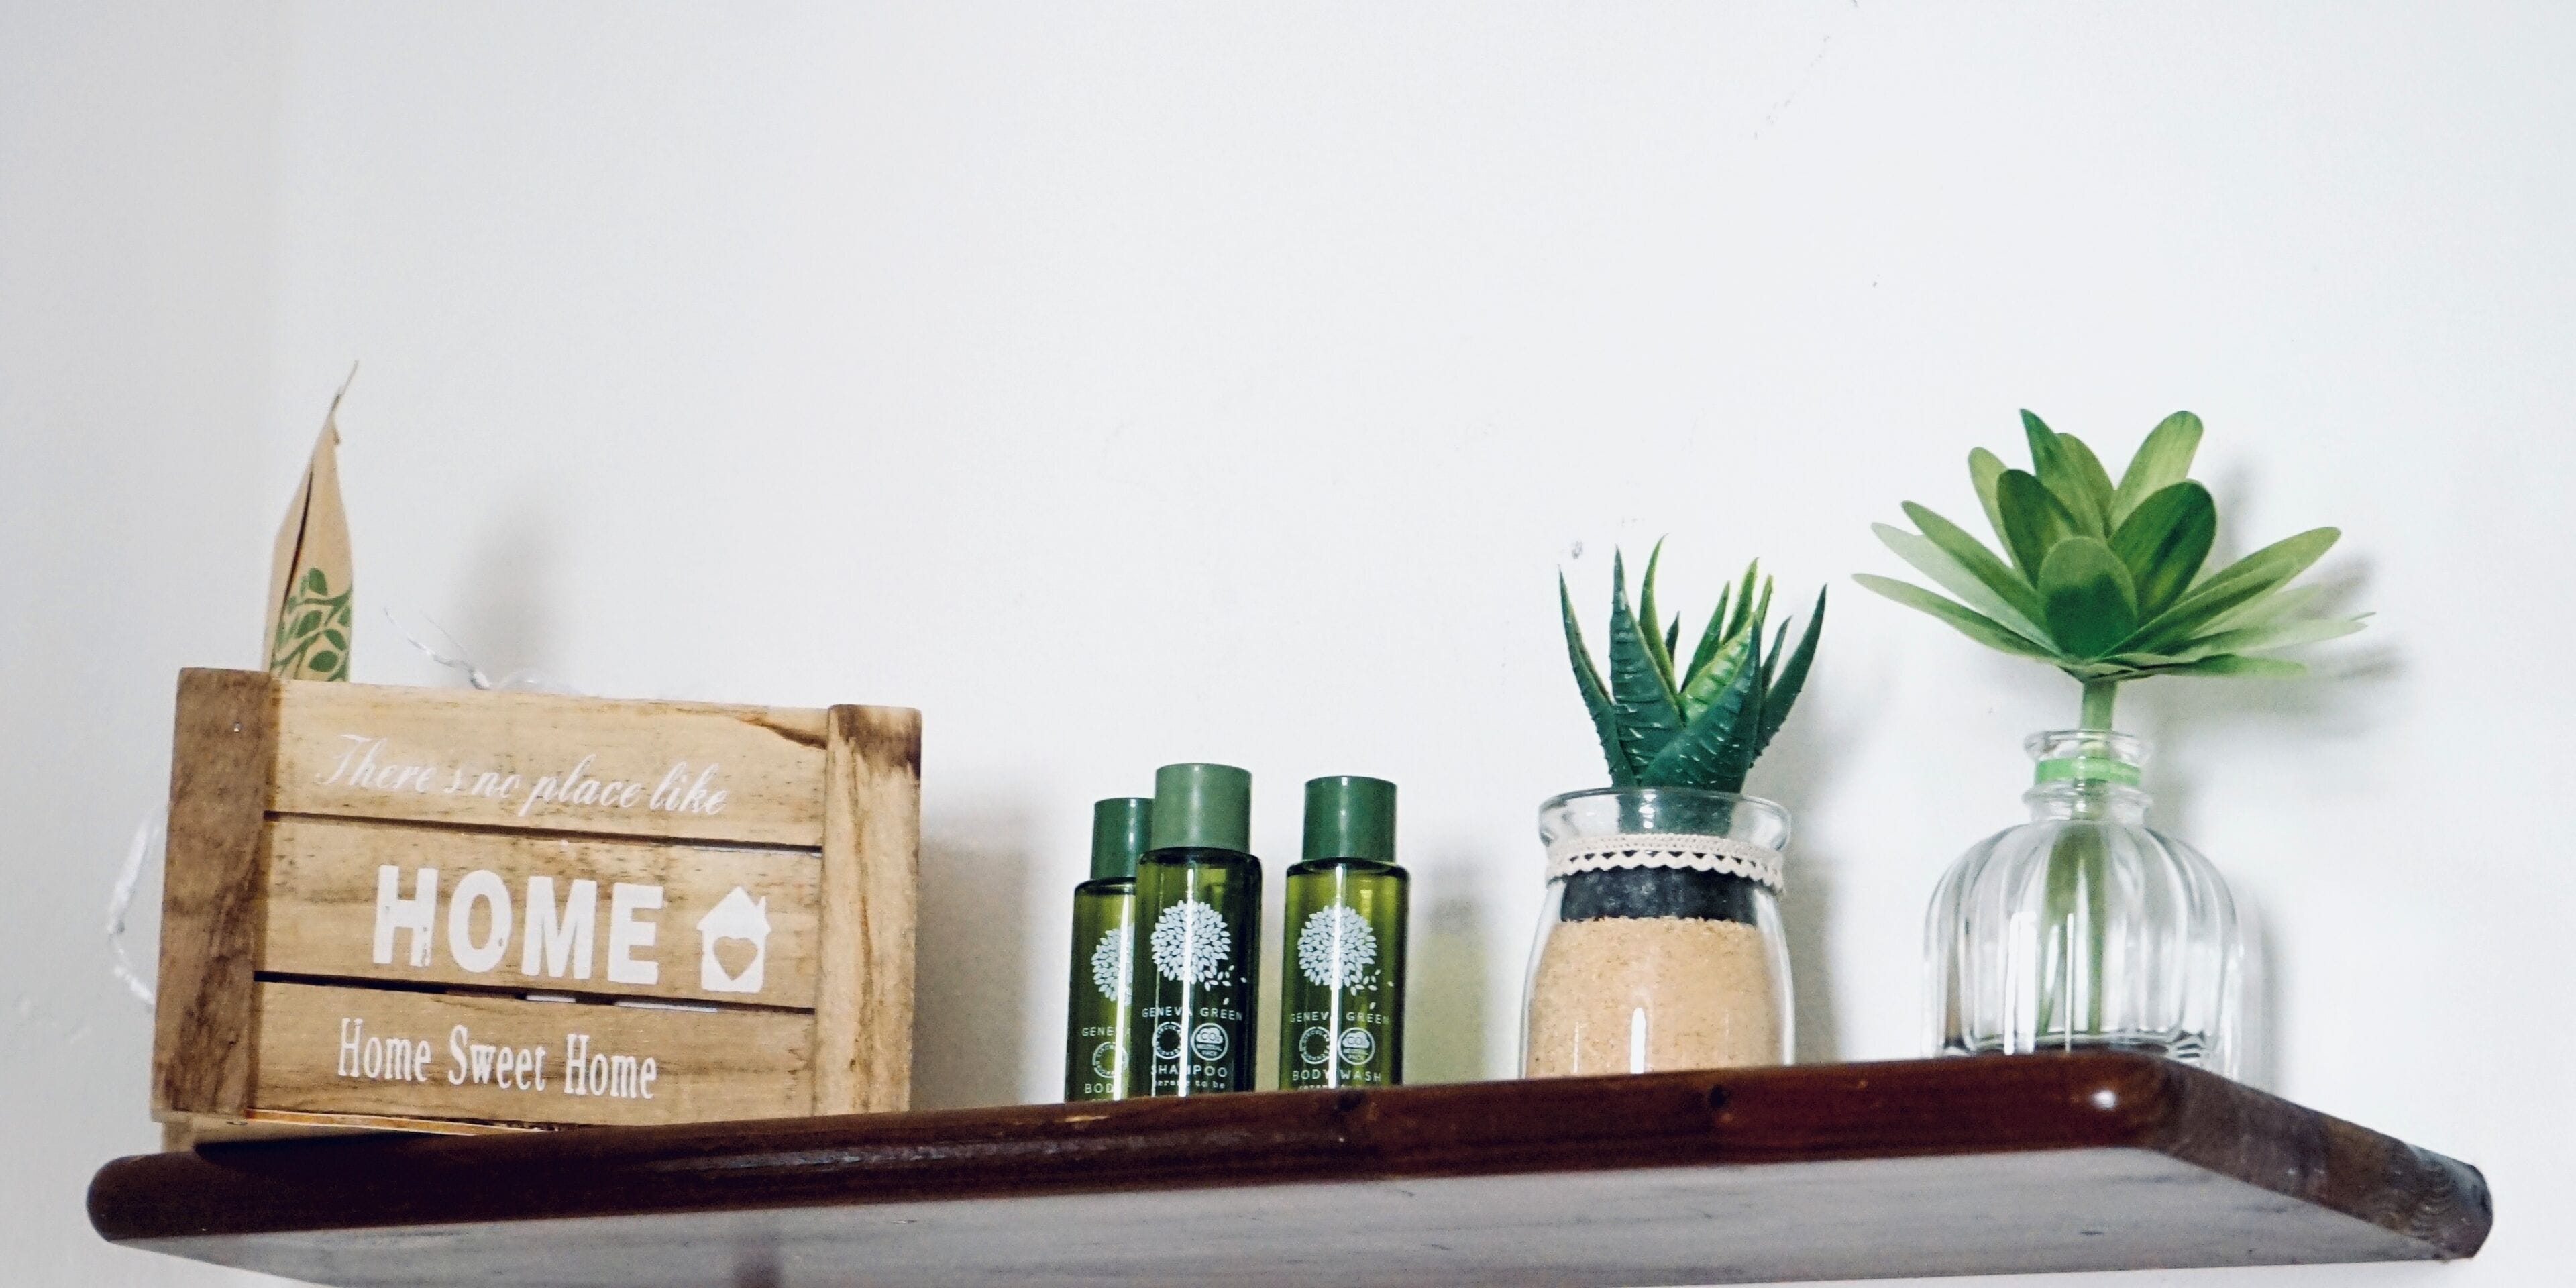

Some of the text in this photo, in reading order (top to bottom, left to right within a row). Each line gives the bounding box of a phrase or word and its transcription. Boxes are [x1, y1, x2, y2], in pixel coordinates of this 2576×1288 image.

[472, 771, 521, 799] no
[518, 754, 643, 817] place
[649, 762, 728, 814] like
[372, 865, 664, 985] HOME
[1199, 1007, 1243, 1021] GREEN
[1290, 1011, 1389, 1025] GENEV GREEN
[337, 1018, 657, 1099] Home Sweet Home
[1340, 1070, 1381, 1082] WASH
